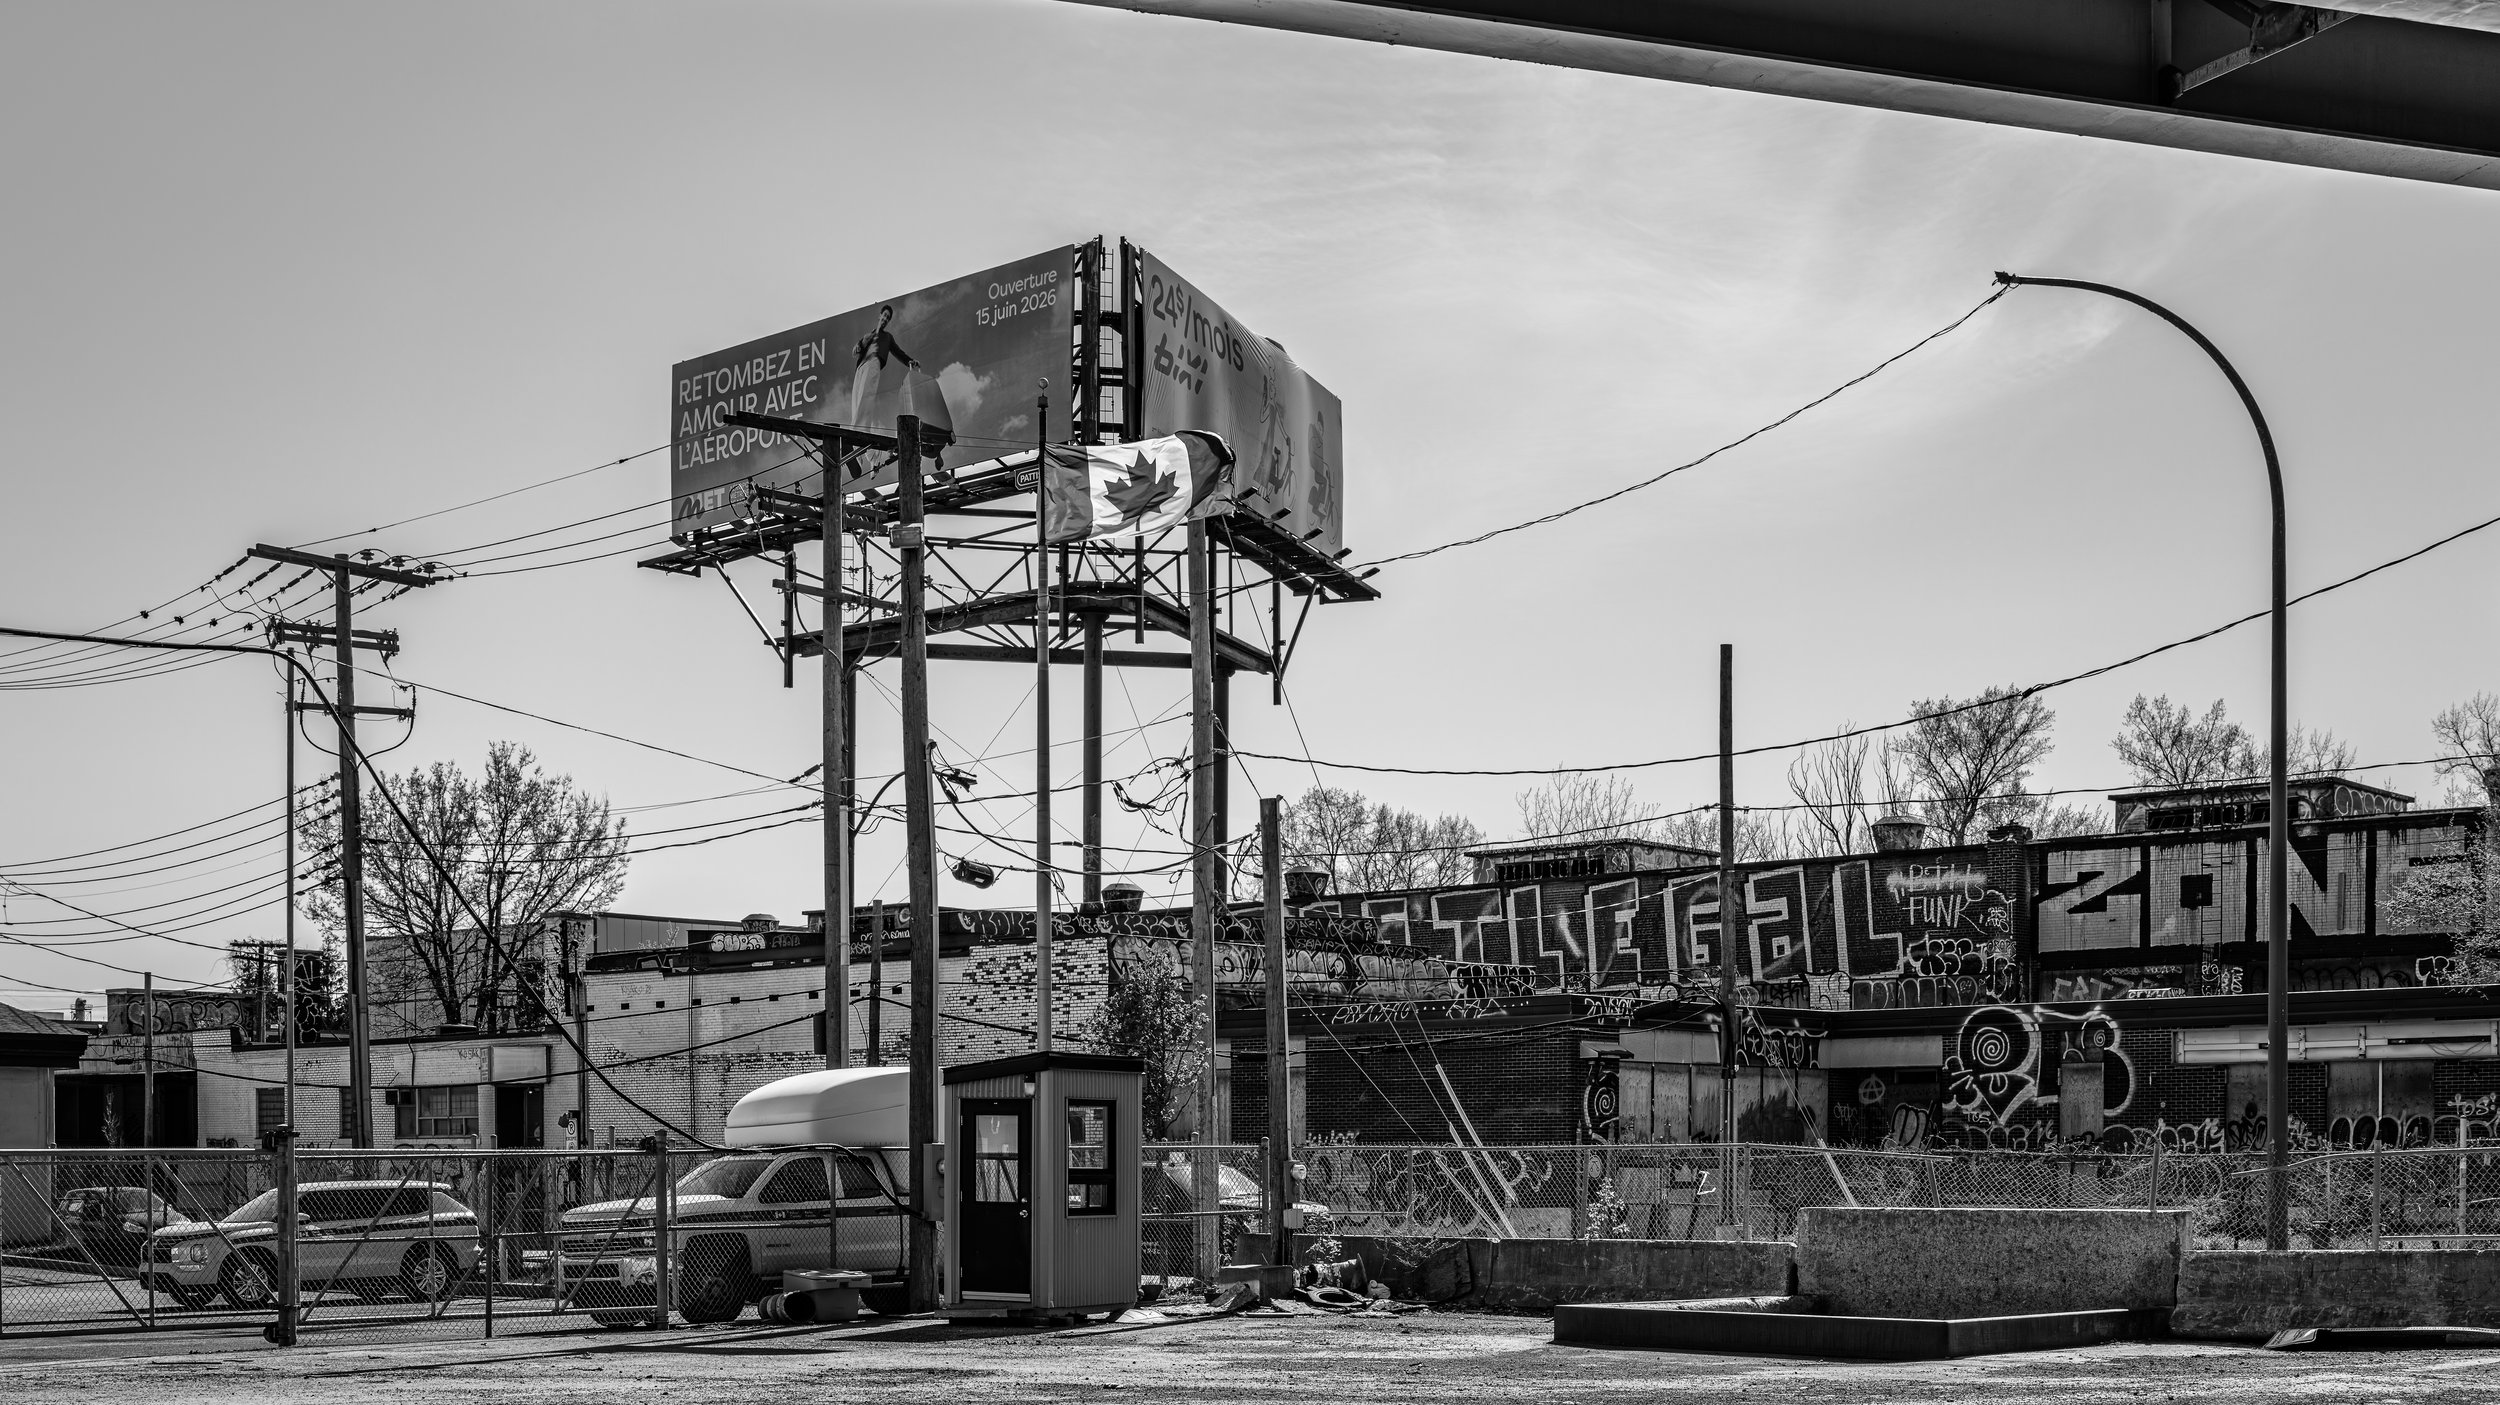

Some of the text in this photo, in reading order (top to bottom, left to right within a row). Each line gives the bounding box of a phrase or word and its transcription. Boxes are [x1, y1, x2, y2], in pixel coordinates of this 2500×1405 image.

[975, 288, 1057, 327] 15 juin 2026
[988, 270, 1058, 300] Ouverture
[679, 338, 826, 406] RETOMBEZ EN
[679, 375, 818, 438] AMOUR AVEC
